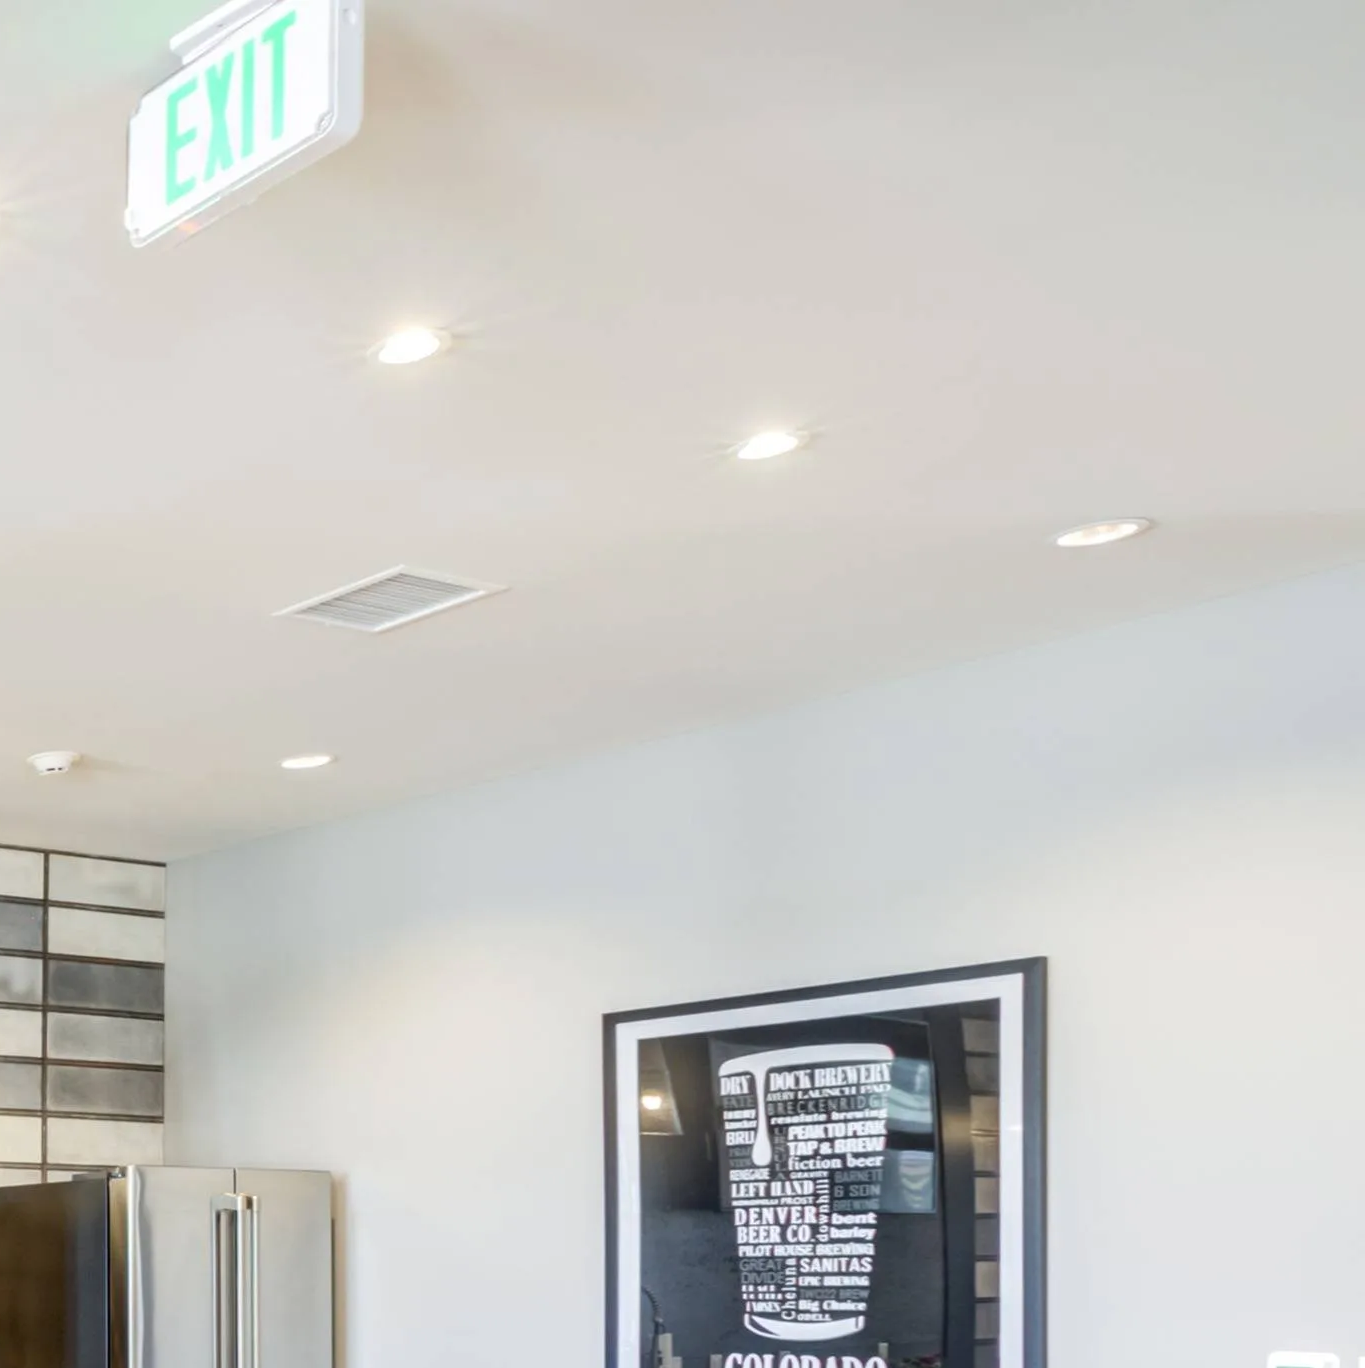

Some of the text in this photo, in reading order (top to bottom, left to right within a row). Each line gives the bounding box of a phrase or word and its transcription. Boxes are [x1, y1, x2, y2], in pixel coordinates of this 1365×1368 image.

[165, 9, 297, 206] EXIT
[721, 1062, 892, 1096] DRY DOCK BREWERY
[797, 1086, 857, 1099] LAUNCH
[860, 1084, 892, 1094] PAD
[768, 1094, 889, 1116] BRECKENRIDGE
[726, 1131, 755, 1146] BRU
[788, 1122, 825, 1141] PEAK
[847, 1120, 887, 1137] PEAK
[787, 1136, 885, 1156] TAP & BREW
[787, 1154, 884, 1171] fiction beer
[731, 1180, 815, 1198] LEFT HAND
[849, 1184, 881, 1197] SON
[734, 1206, 818, 1226] DENVER
[815, 1179, 830, 1242] downhill
[831, 1212, 878, 1225] bent
[737, 1225, 815, 1244] BEER CO.
[829, 1227, 877, 1240] barley
[738, 1245, 773, 1257] PILOT
[816, 1243, 875, 1256] BREWING
[739, 1258, 785, 1271] GREAT
[800, 1257, 873, 1273] SANITAS
[741, 1272, 785, 1285] DIVIDE
[798, 1300, 867, 1312] Big Choice
